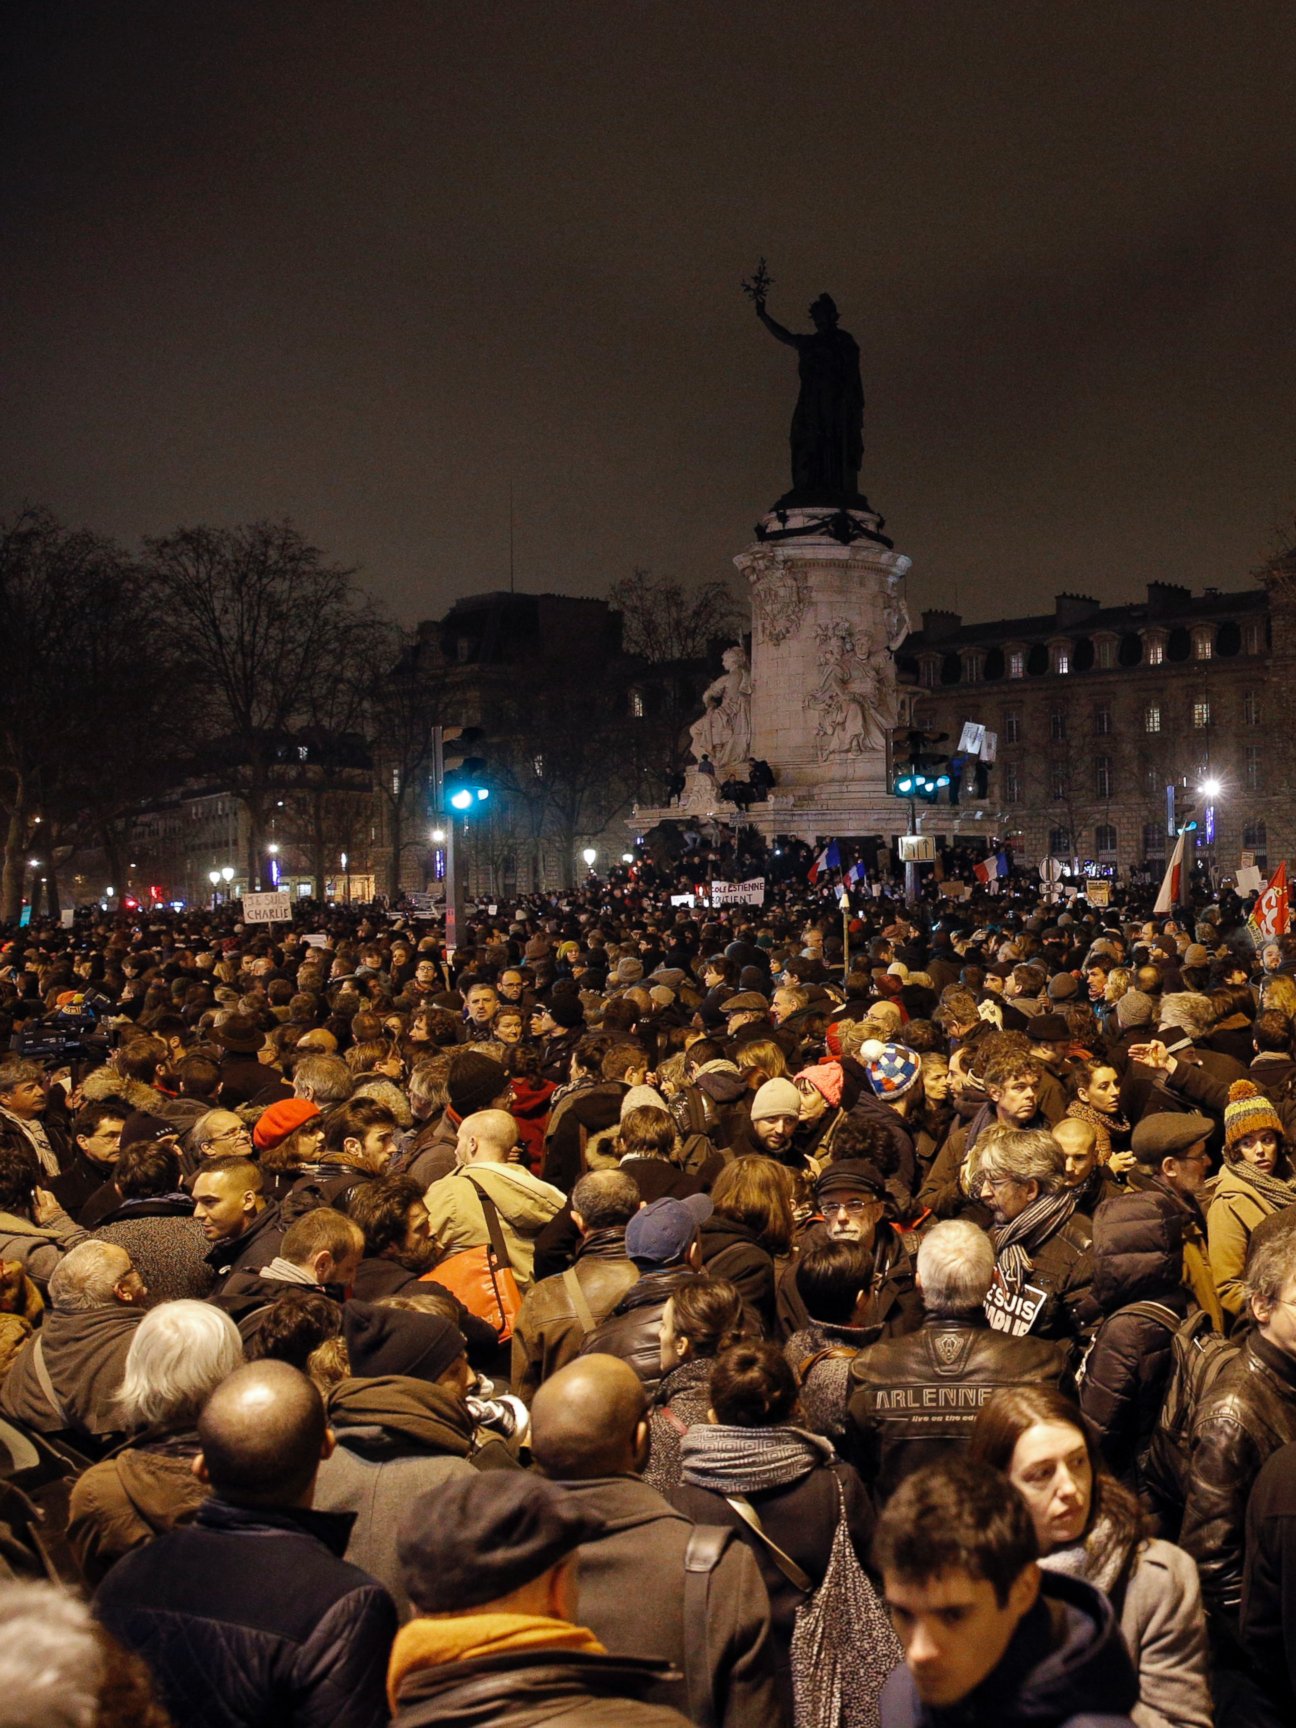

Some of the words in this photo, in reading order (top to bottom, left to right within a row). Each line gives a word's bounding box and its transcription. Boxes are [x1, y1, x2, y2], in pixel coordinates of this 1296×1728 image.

[727, 882, 765, 893] ESTIENNE
[248, 896, 261, 907] JE
[264, 893, 288, 906] SUIS
[246, 906, 289, 920] CHARLIE
[993, 1287, 1036, 1321] SUIS
[876, 1388, 993, 1409] ARLENNE
[945, 1414, 961, 1422] the
